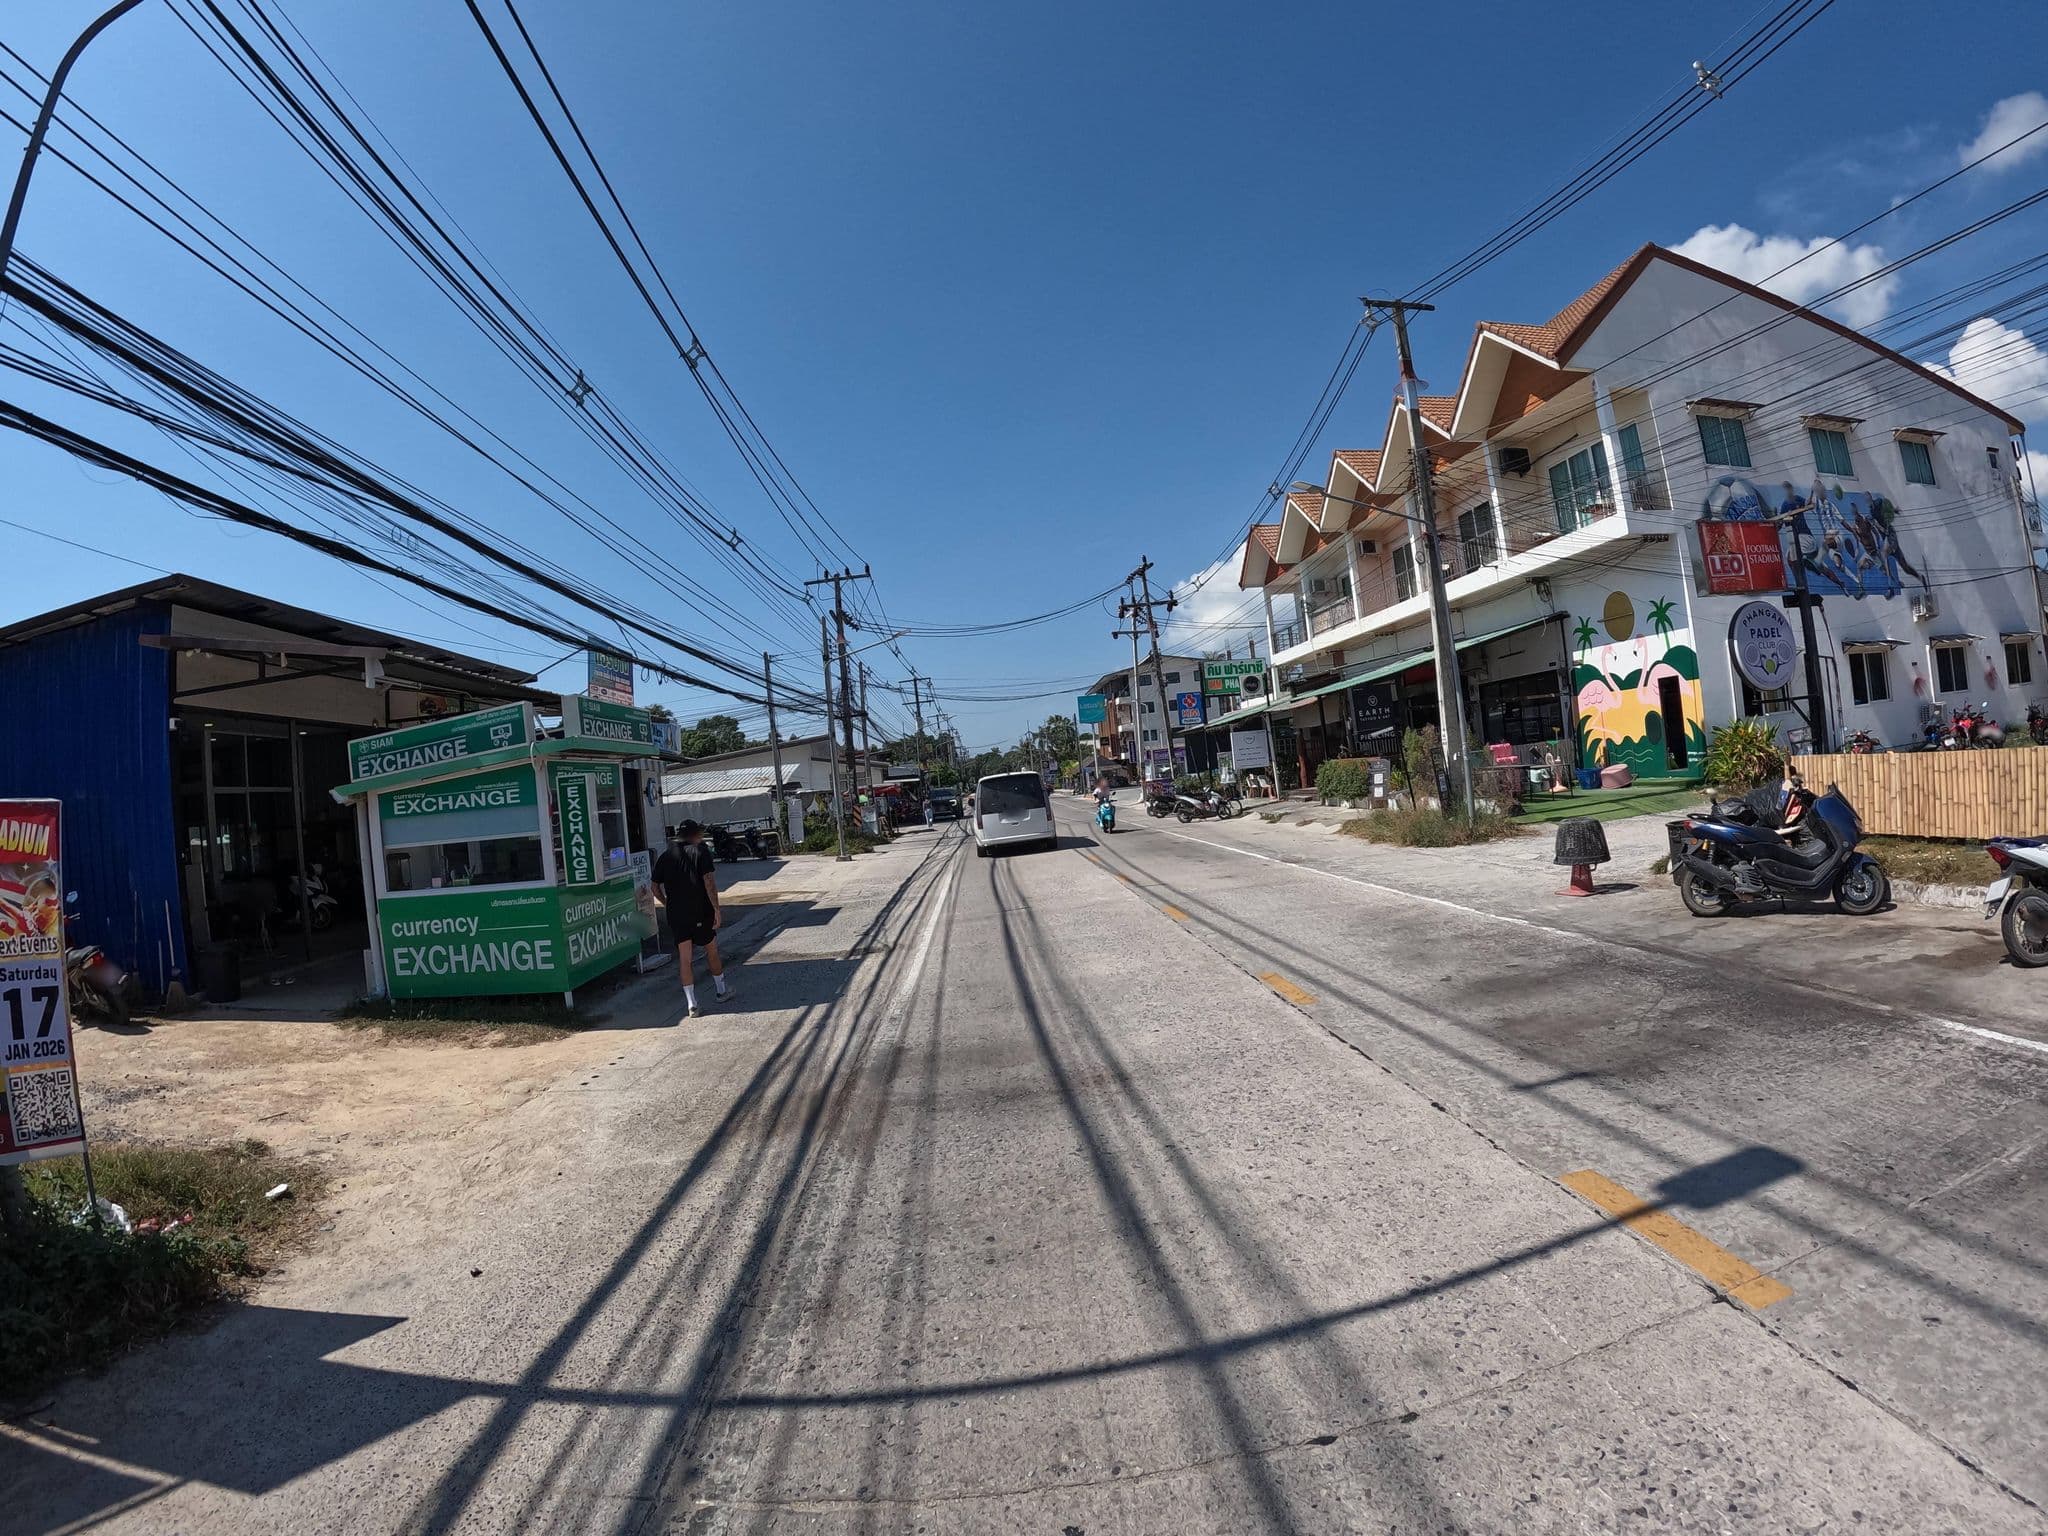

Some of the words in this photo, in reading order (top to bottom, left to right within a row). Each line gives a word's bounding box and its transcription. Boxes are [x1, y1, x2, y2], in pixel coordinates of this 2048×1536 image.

[1747, 544, 1779, 553] FOOTBALL
[1711, 557, 1741, 575] LEO
[1749, 555, 1781, 564] STADIUM
[1742, 608, 1785, 627] PHANGAN
[1749, 627, 1782, 638] PADEL
[1758, 641, 1776, 649] CLUB
[1359, 707, 1391, 717] EARTH
[583, 718, 633, 739] EXCHANGE
[371, 737, 394, 750] SIAM
[358, 738, 469, 778] EXCHANGE
[393, 792, 425, 800] currency
[393, 789, 521, 815] EXCHANGE
[567, 786, 588, 881] EXCHANGE
[565, 897, 607, 924] currency
[391, 915, 479, 937] currency
[19, 935, 59, 954] Events
[393, 940, 555, 976] EXCHANGE
[0, 967, 57, 982] Saturday
[3, 985, 60, 1041] 17
[5, 1043, 31, 1062] JAN
[33, 1039, 66, 1058] 2026
